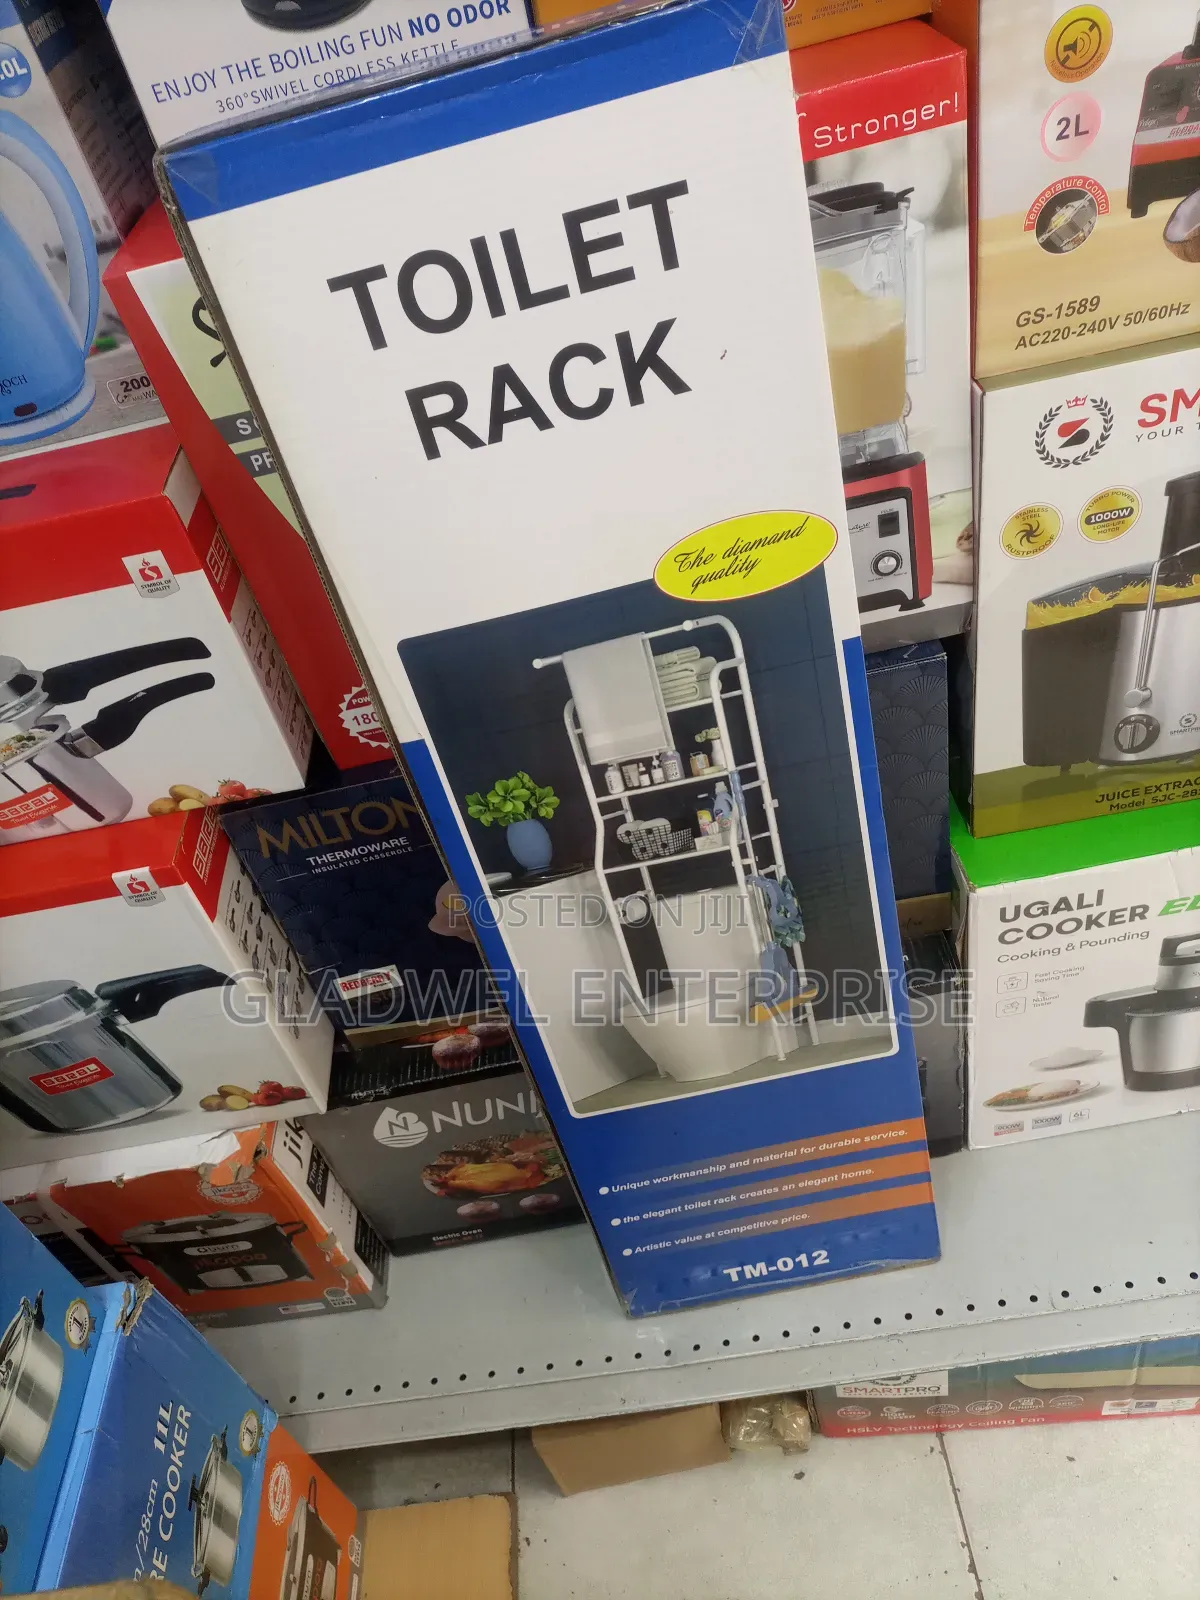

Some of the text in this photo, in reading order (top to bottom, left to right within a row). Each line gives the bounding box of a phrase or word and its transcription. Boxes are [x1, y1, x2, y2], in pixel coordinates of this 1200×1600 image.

[151, 0, 511, 103] ENJOY THE BOILING FUN NO ODOR
[814, 92, 959, 149] Stronger!
[1056, 113, 1090, 142] 2L
[1025, 178, 1108, 226] Temperature Control
[327, 179, 689, 351] TOILET
[1016, 295, 1101, 328] GS-1589
[1015, 302, 1191, 350] AC220-240V 50/60Hz
[405, 317, 692, 459] RACK
[1136, 425, 1184, 442] YOUR
[1111, 491, 1135, 504] POWER
[1014, 507, 1049, 519] STAINLESS
[1021, 513, 1041, 522] STEEL
[1090, 507, 1131, 523] 1000W
[1097, 526, 1120, 535] MOTOR
[1005, 534, 1055, 556] RUSTPROOF
[674, 546, 716, 573] The
[140, 581, 163, 590] SYMBOL
[691, 555, 762, 595] quality
[147, 585, 171, 594] QUALITY
[1095, 788, 1140, 803] JUICE
[1109, 800, 1145, 811] Model
[306, 836, 409, 866] THERMOWARE
[311, 846, 413, 874] INSULATED CASSEROLE
[999, 888, 1105, 924] UGALI
[998, 904, 1150, 945] COOKER
[997, 930, 1150, 964] Cooking & Pounding
[340, 971, 392, 991] REDBERRY
[1053, 965, 1086, 976] Cooking
[1062, 972, 1081, 980] Time
[431, 1089, 543, 1134] NUNI
[611, 1130, 908, 1194] Unique workmanship and material for durable service.
[623, 1167, 875, 1225] the elegant toilet rack creates an elegant home.
[432, 1228, 483, 1241] Electric Oven
[634, 1212, 811, 1254] Artistic value at competitive price.
[722, 1249, 830, 1283] TM-012
[842, 1385, 941, 1394] SMARTPRO
[887, 1421, 965, 1433] Technology
[968, 1417, 1016, 1428] Ceiling
[1020, 1416, 1046, 1425] Fan
[159, 1404, 192, 1542] COOKER
